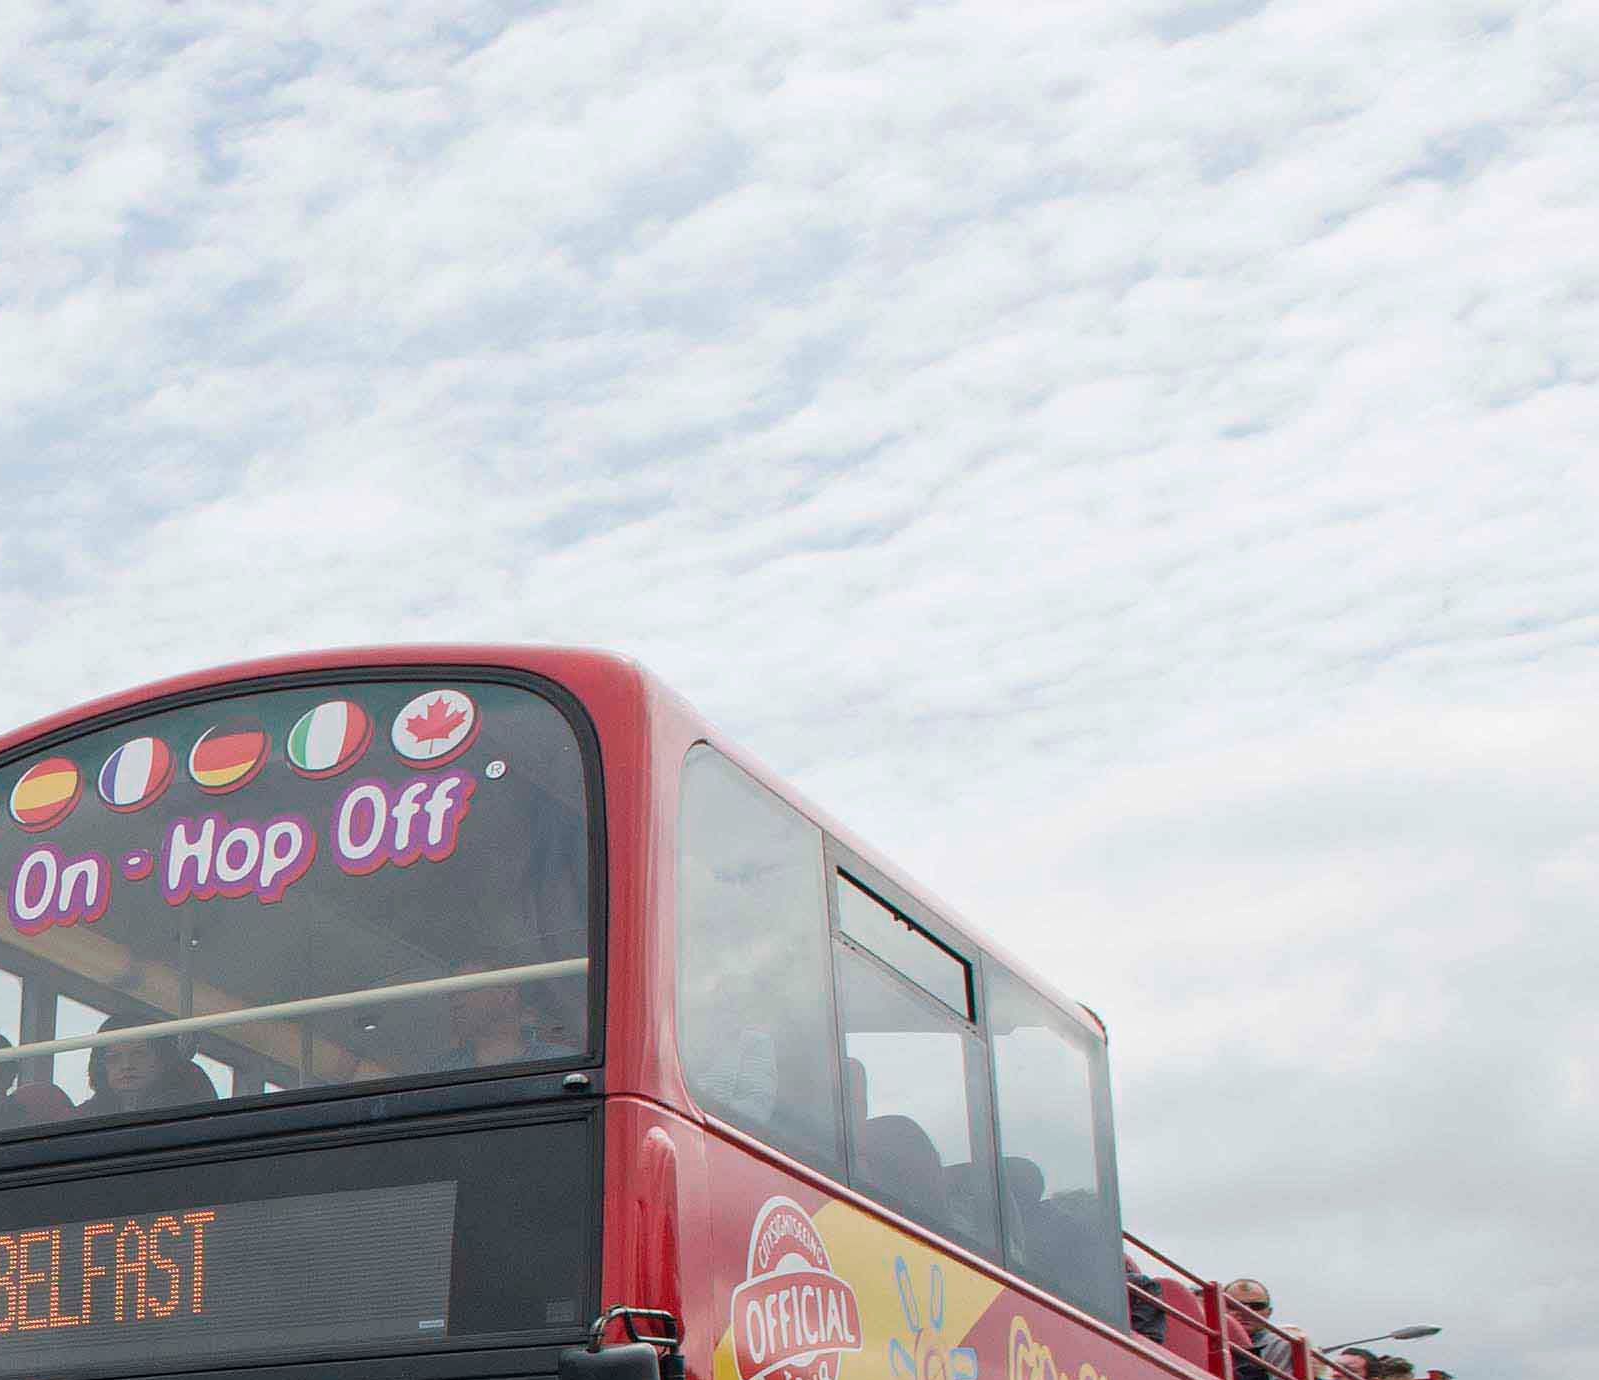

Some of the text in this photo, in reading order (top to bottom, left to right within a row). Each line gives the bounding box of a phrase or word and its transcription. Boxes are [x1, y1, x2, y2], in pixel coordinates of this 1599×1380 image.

[14, 849, 102, 922] On
[166, 817, 305, 893] Hop
[336, 774, 465, 862] Off
[746, 1284, 856, 1364] OFFICIAL
